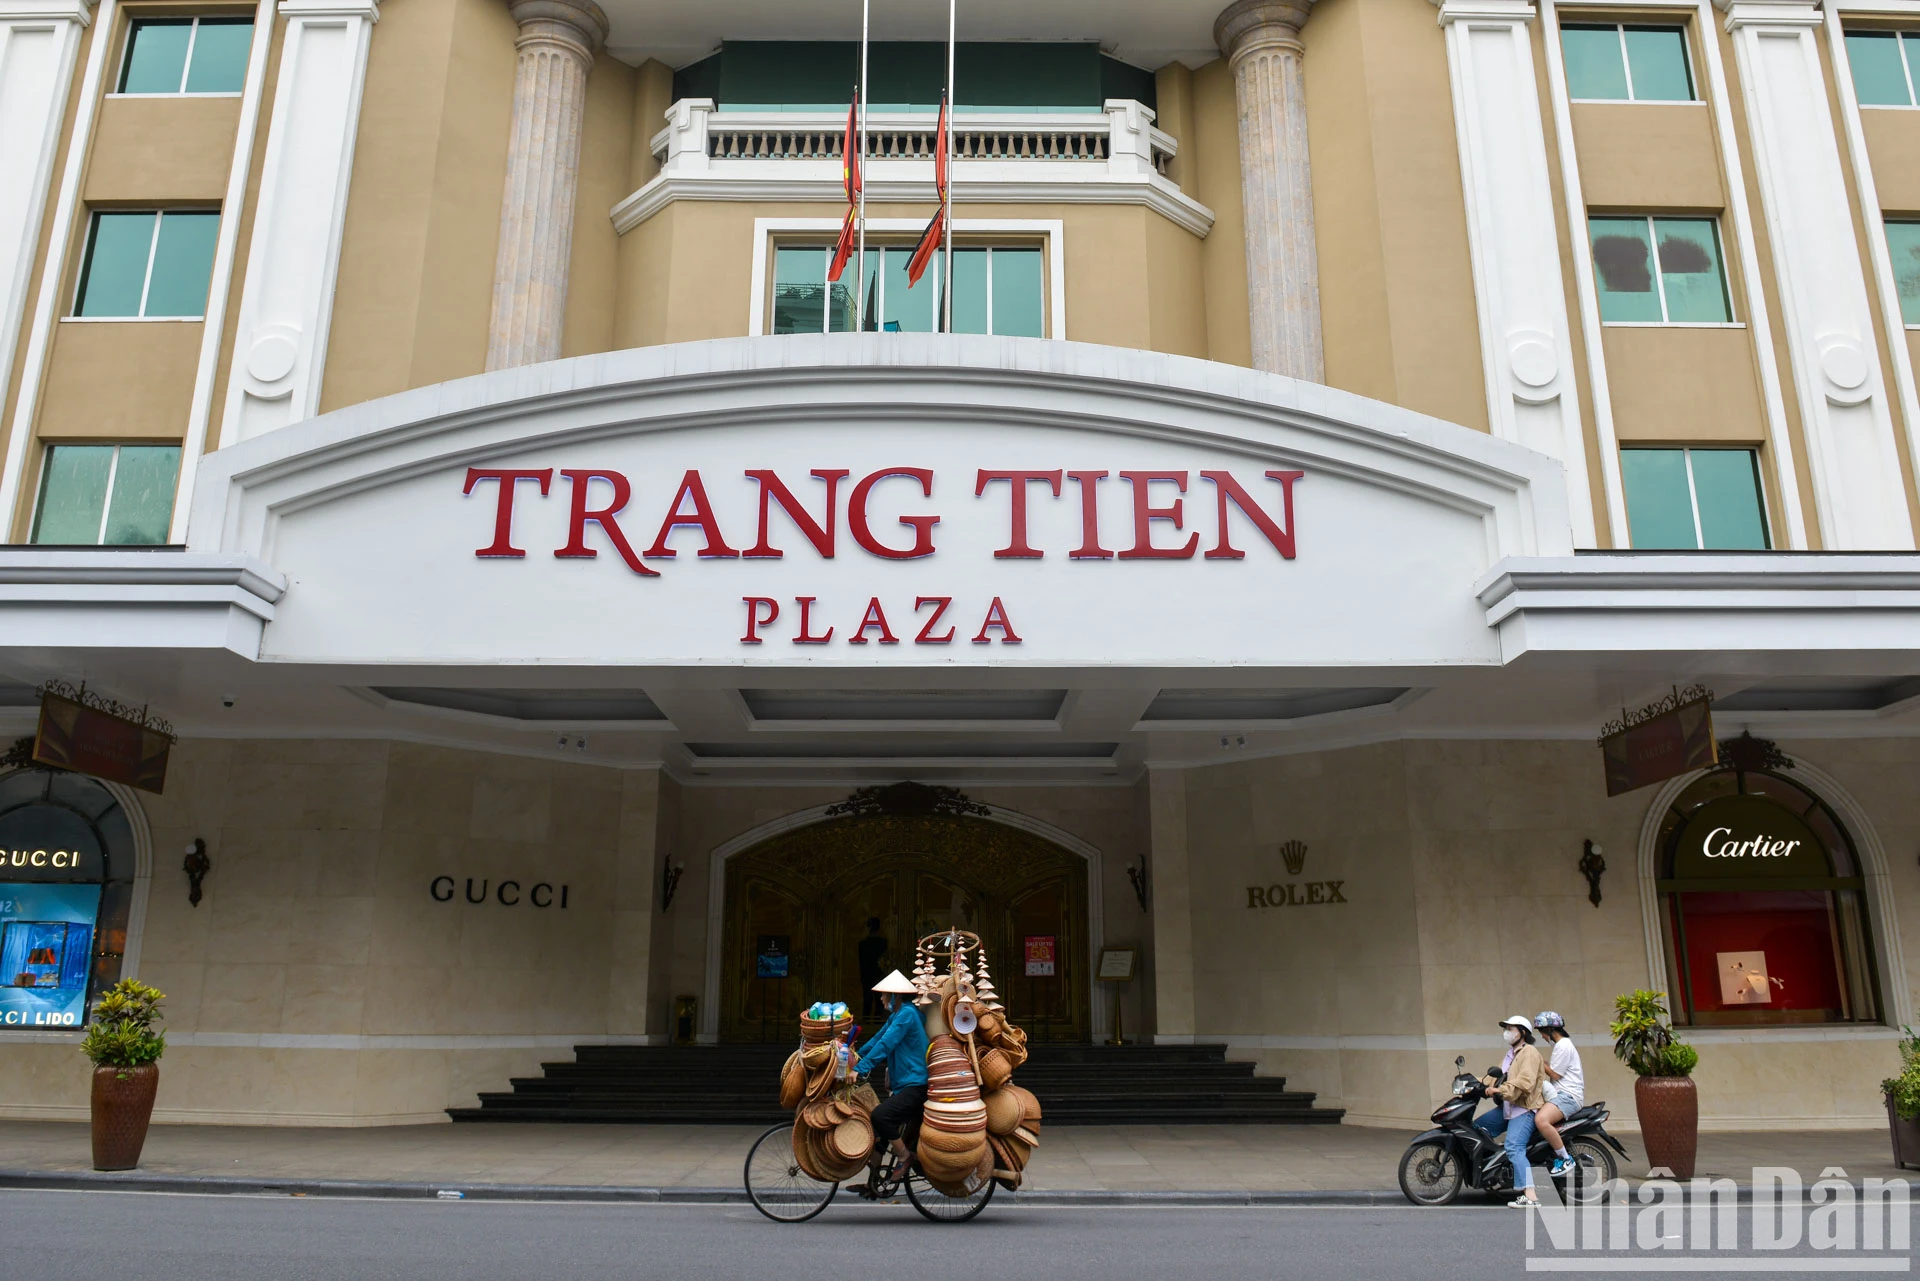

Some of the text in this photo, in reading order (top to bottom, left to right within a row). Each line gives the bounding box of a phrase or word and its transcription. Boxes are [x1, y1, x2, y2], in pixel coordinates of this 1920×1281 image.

[462, 467, 1304, 576] TRANG TIEN
[740, 596, 1023, 644] PLAZA
[1703, 827, 1800, 857] Cartier
[430, 875, 569, 909] GUCCI
[1246, 880, 1348, 909] ROLEX
[35, 1011, 75, 1026] LIDO
